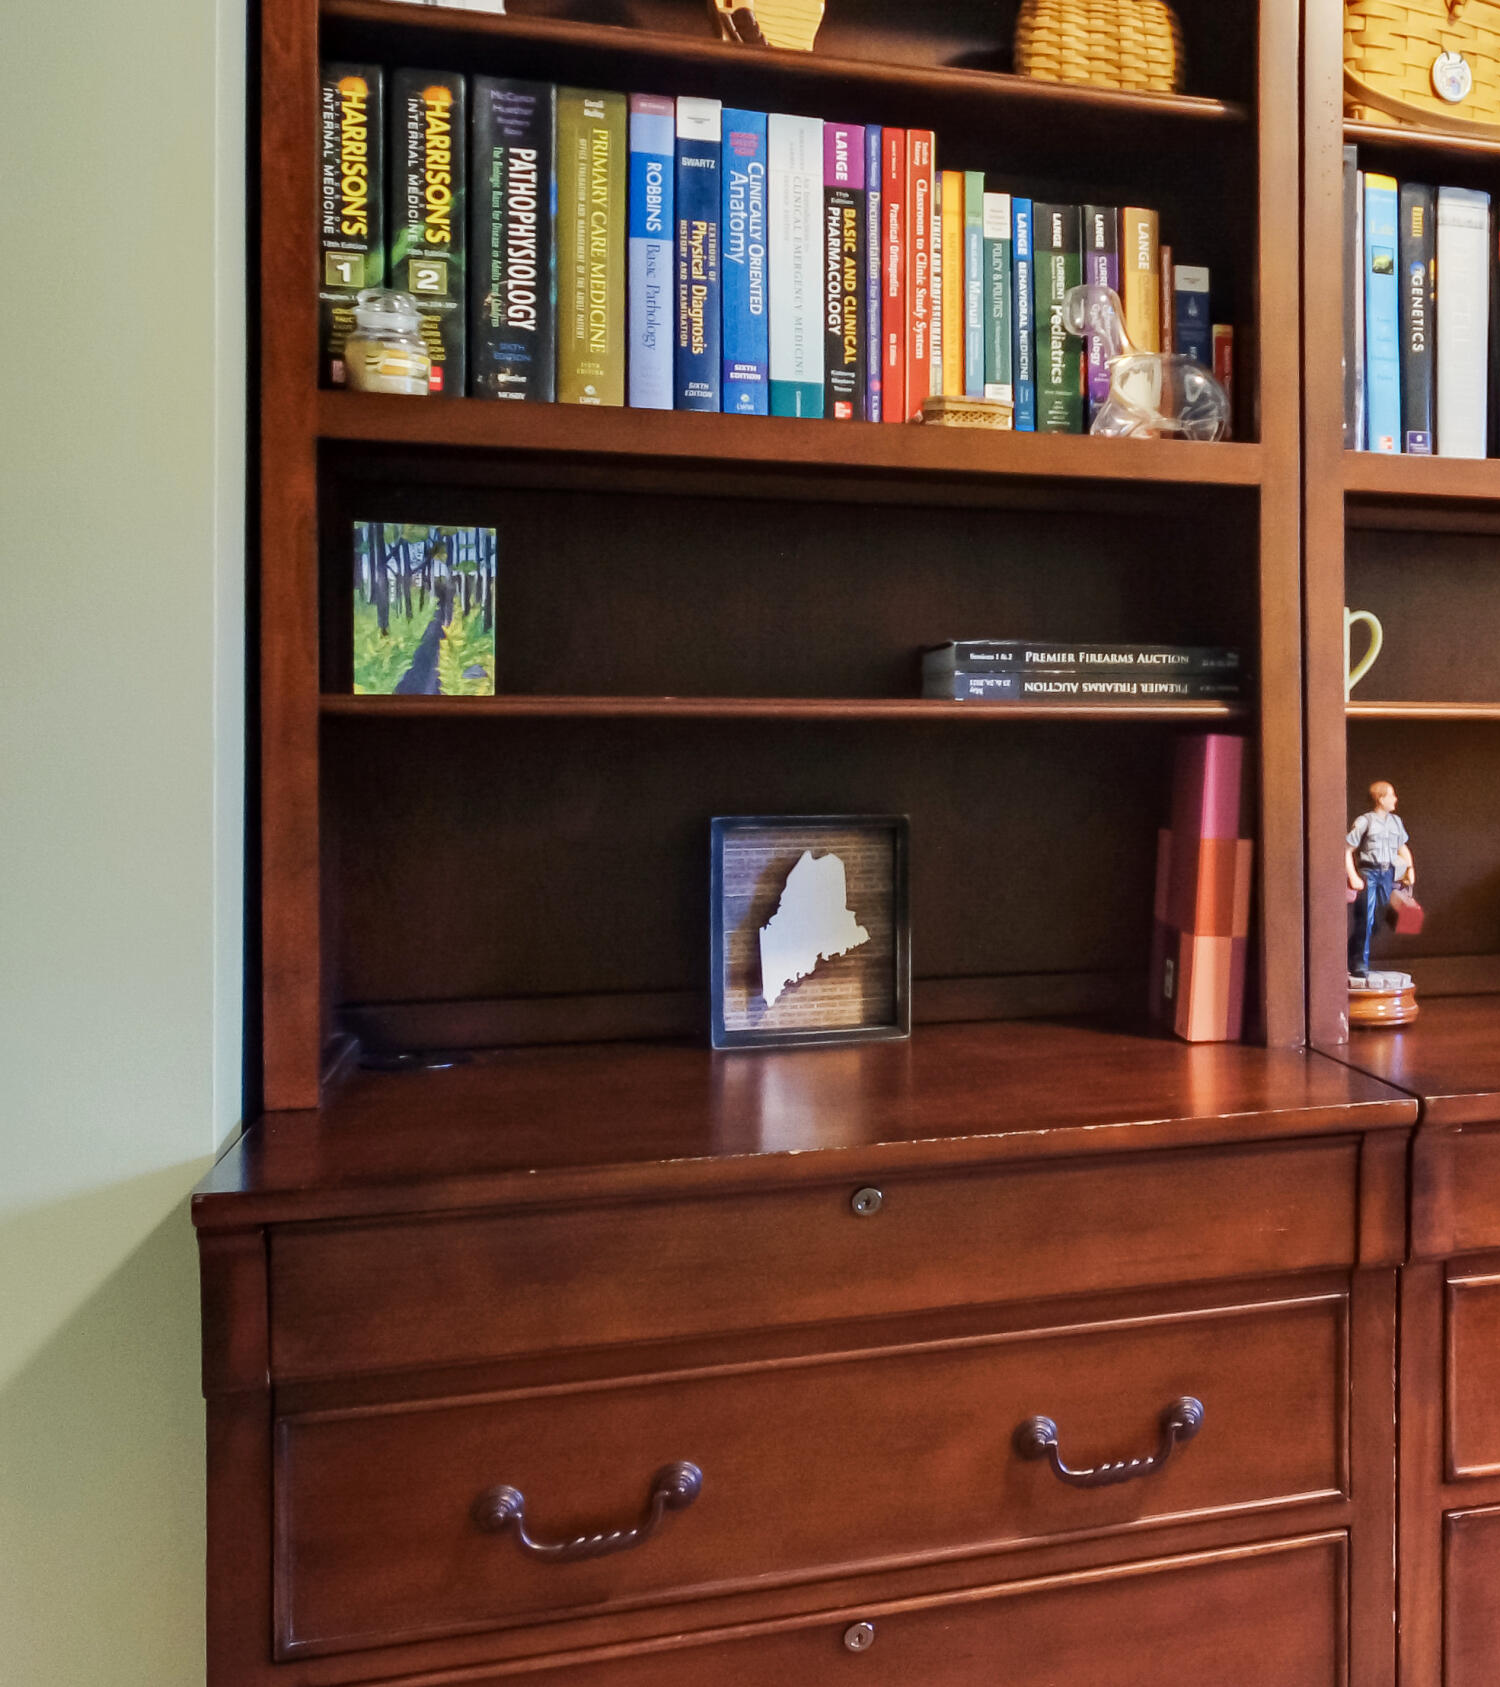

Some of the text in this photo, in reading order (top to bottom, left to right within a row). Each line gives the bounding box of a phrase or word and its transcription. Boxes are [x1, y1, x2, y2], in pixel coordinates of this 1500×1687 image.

[323, 87, 335, 234] INTERNAL MEDICINE
[341, 90, 368, 237] HARRISON'S
[407, 98, 419, 242] INTERNAL MEDICINE
[425, 99, 452, 244] HARRISON'S
[591, 128, 609, 208] PRIMARY
[681, 156, 716, 169] SWARTZ
[835, 131, 849, 181] LANGE
[491, 191, 503, 208] Basis
[645, 162, 663, 232] ROBBINS
[724, 170, 749, 265] Anatomy
[491, 223, 503, 248] Disease
[507, 147, 537, 332] PATHOPHYSIOLOGY
[590, 210, 608, 258] CARE
[747, 161, 765, 315] CLINICALLY ORIENTED
[868, 192, 881, 279] Documentation
[888, 203, 900, 243] Practical
[1016, 212, 1029, 255] LANGE
[1052, 212, 1063, 248] LANGE
[1095, 213, 1105, 249] LANGE
[1137, 222, 1150, 271] LANGE
[336, 262, 351, 283] 1
[416, 270, 440, 290] 2
[491, 260, 502, 281] Adults
[827, 206, 842, 337] PHARMACOLOGY
[912, 178, 928, 359] Classroom to Clinic Study System
[991, 242, 1003, 272] POLICY
[992, 273, 1003, 281] &
[1098, 256, 1108, 287] CURRE
[641, 244, 662, 351] Basic Pathology
[679, 219, 688, 348] HISTORY AND EXAMINATION
[688, 220, 708, 355] Physical Diagnosis
[843, 208, 858, 365] BASIC AND CLINICAL
[968, 280, 981, 328] Manual
[992, 282, 1003, 318] POLITICS
[589, 263, 606, 354] MEDICINE
[868, 299, 879, 336] Physician
[1018, 261, 1029, 381] BEHAVIORAL MEDICINE
[793, 317, 804, 377] MEDICINE
[869, 338, 879, 375] Assistants
[1050, 304, 1067, 385] Pediatrics
[1024, 651, 1076, 664] PREMIER
[1078, 651, 1134, 664] FIREARMS
[1137, 653, 1190, 665] AUCTION
[1023, 681, 1079, 693] AUCTION
[1082, 681, 1138, 695] FIREARMS
[1140, 682, 1188, 694] PREMIER
